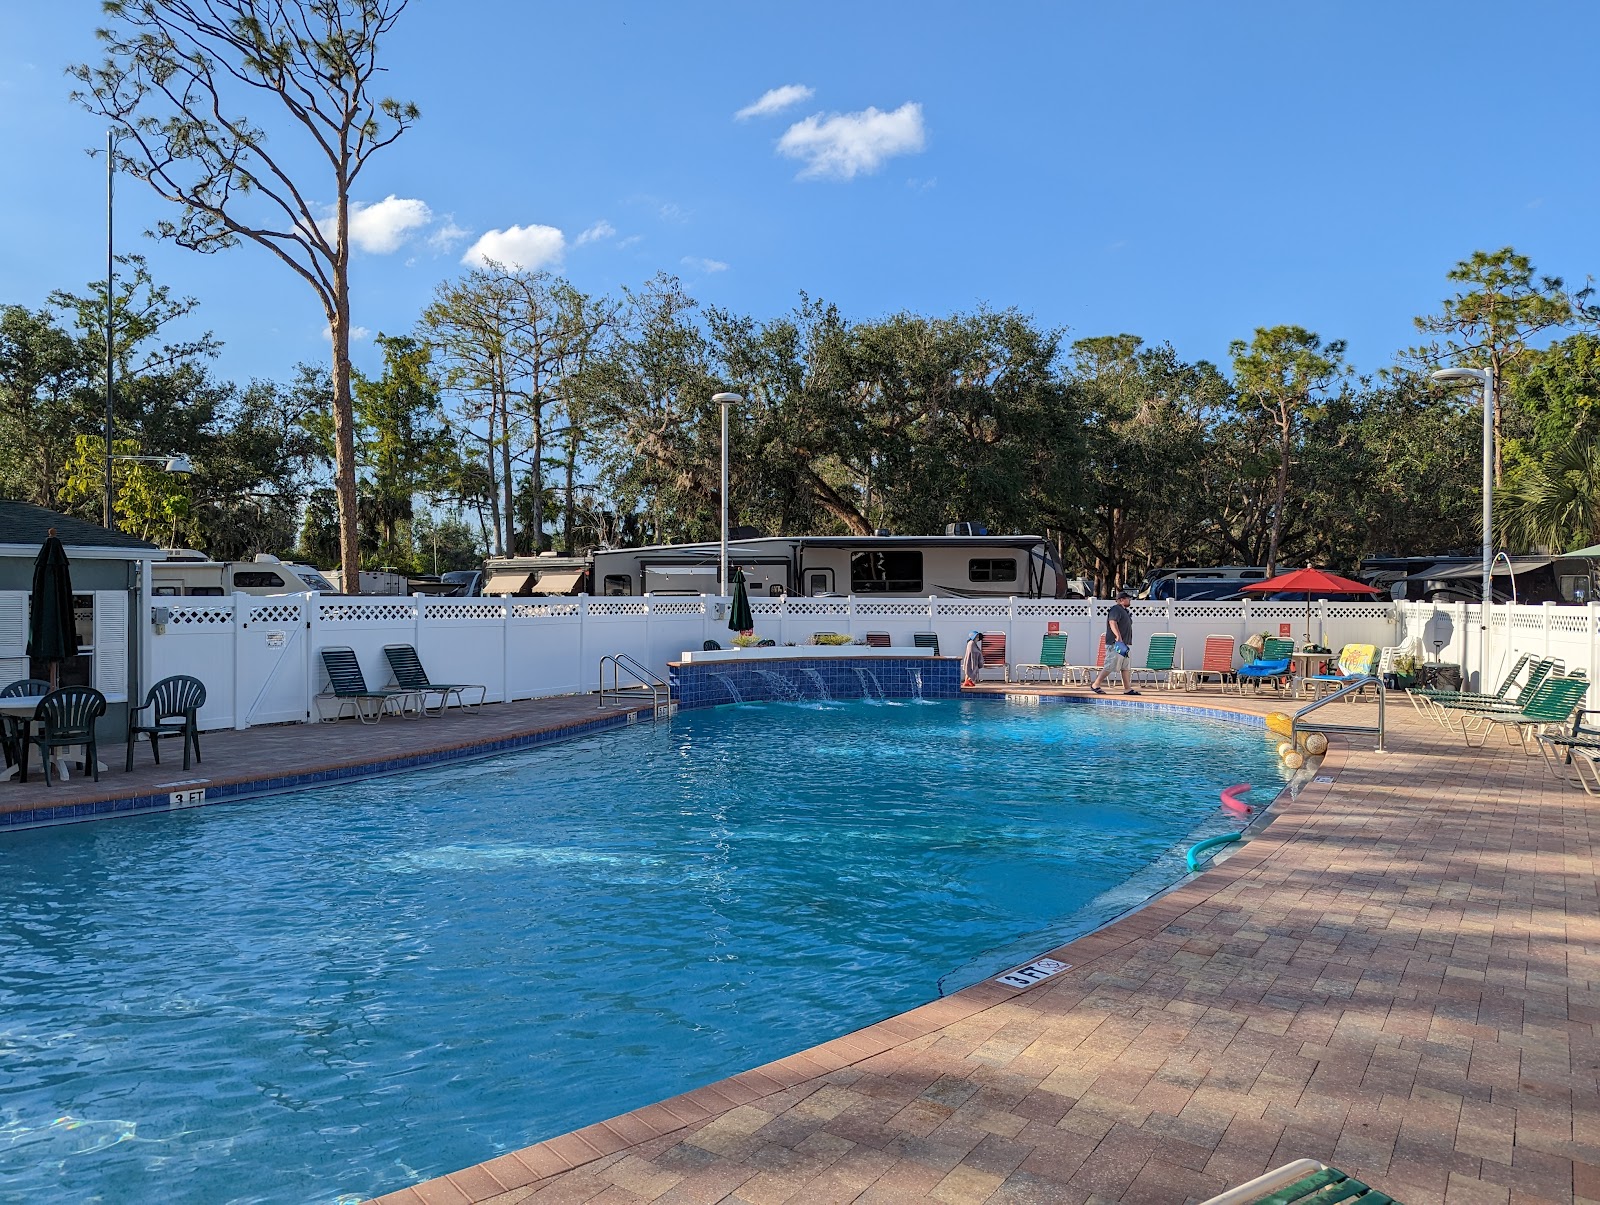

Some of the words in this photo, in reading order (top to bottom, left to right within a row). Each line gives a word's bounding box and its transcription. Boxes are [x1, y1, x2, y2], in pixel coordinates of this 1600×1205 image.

[175, 794, 183, 803] 3
[189, 791, 204, 802] FT
[1004, 976, 1030, 985] 3
[1017, 966, 1050, 979] FT
